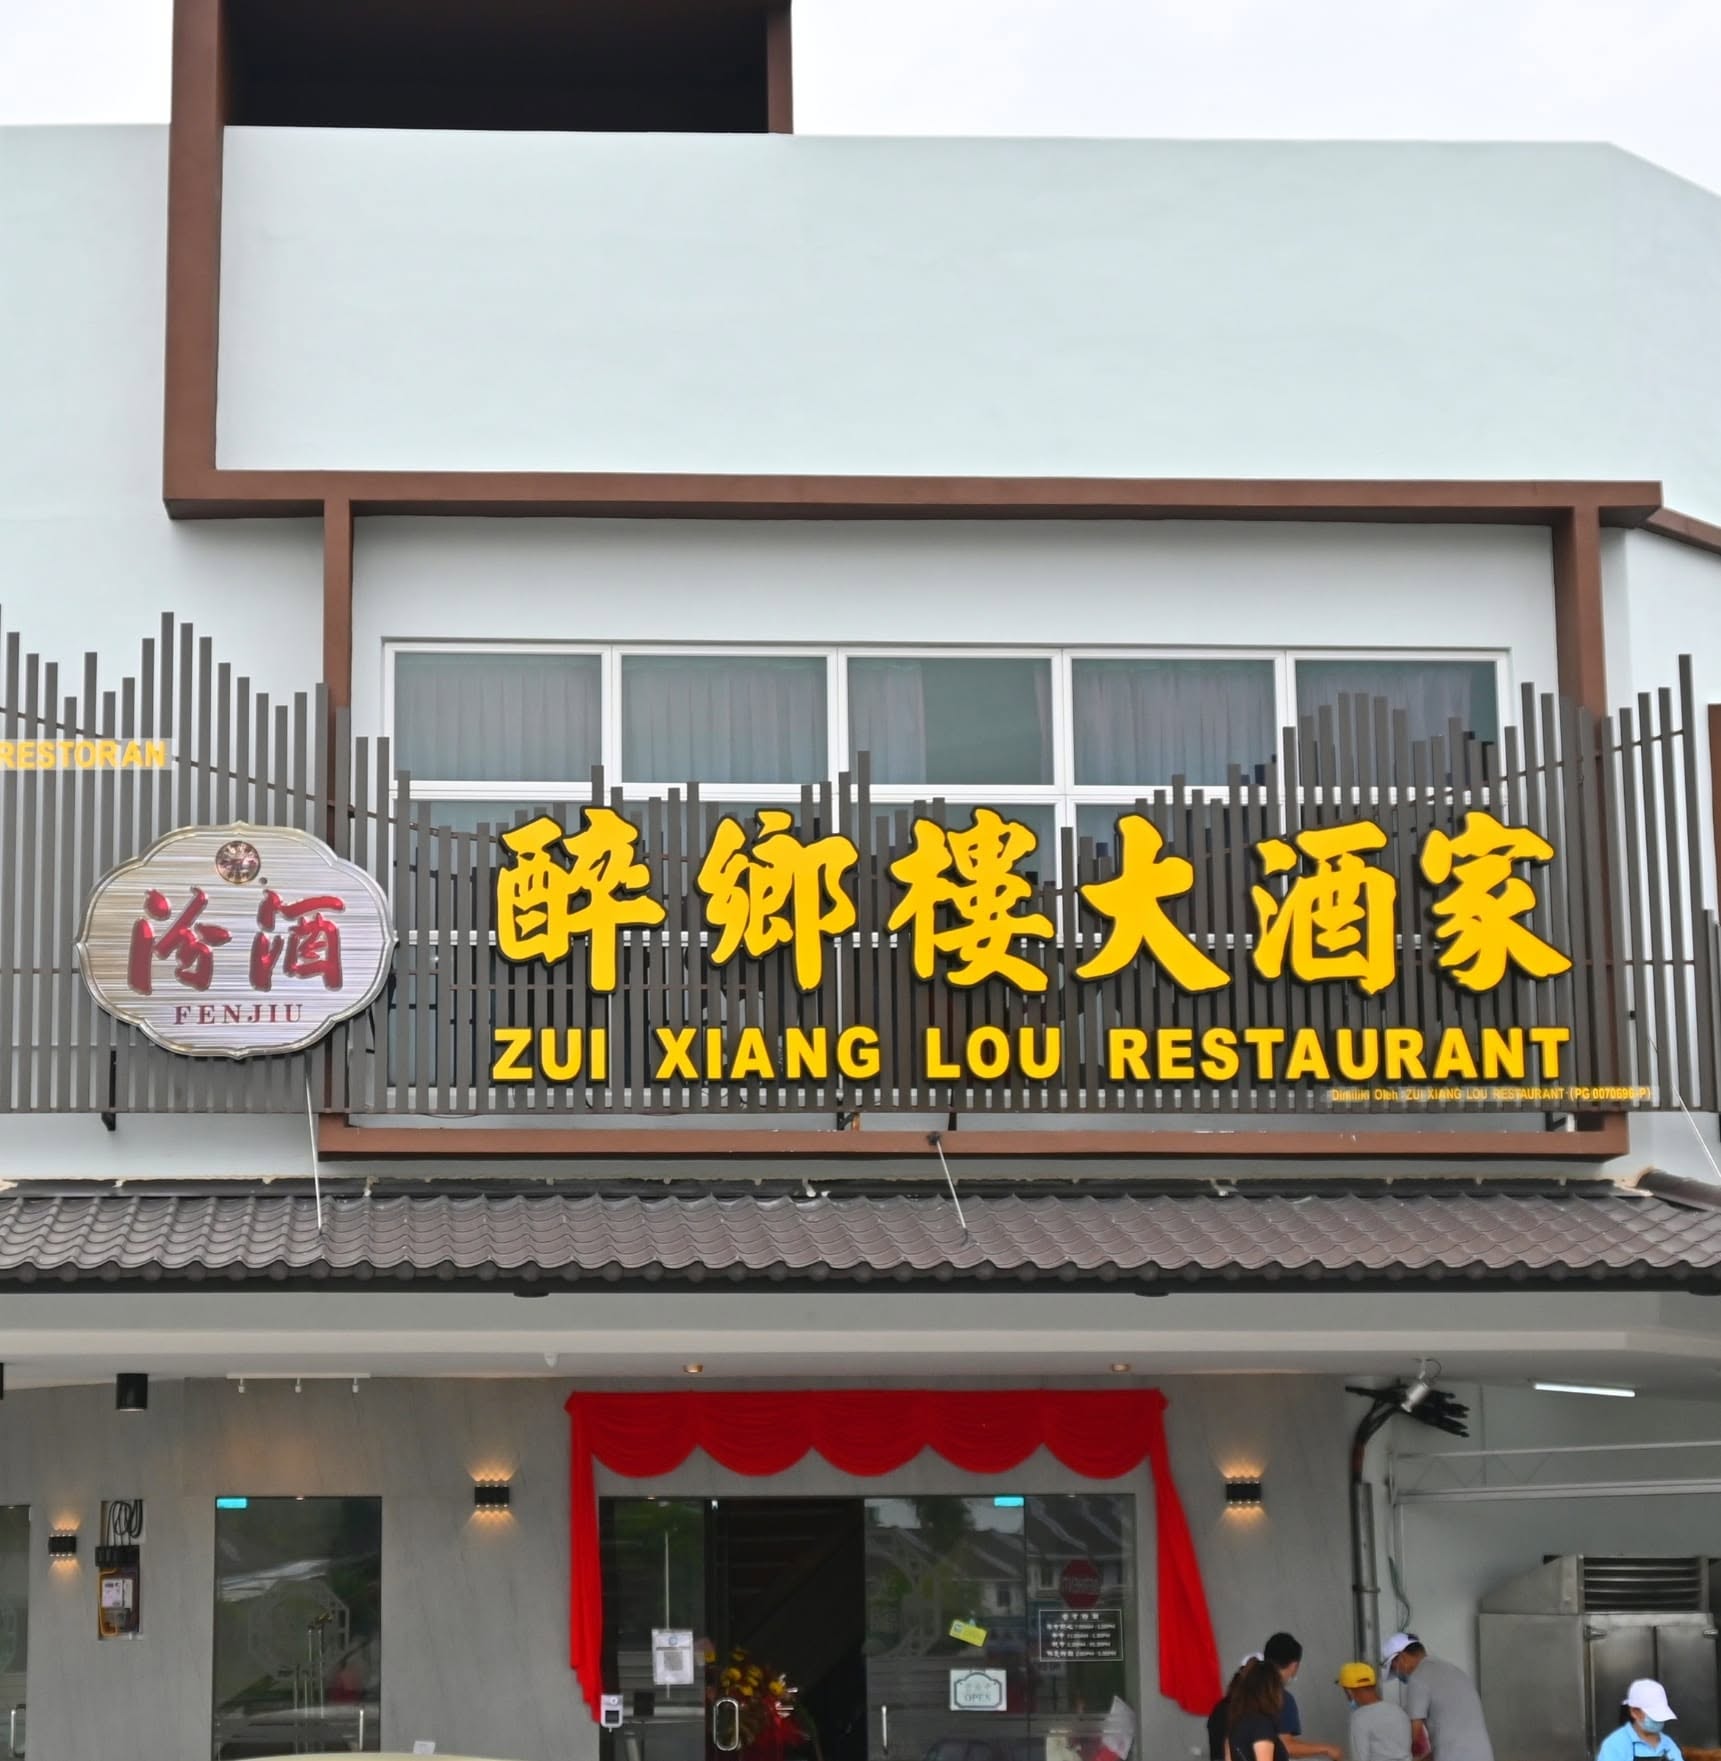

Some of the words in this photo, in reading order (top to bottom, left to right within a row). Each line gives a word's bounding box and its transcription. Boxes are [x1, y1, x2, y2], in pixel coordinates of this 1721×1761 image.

[0, 740, 166, 769] RESTORAN
[497, 808, 1573, 995] 醉鄉樓大酒家
[127, 883, 346, 995] 汾酒
[173, 1003, 304, 1025] FENJIU
[492, 1027, 607, 1081] ZUI
[655, 1025, 881, 1081] XIANG
[925, 1026, 1061, 1080] LOU
[1108, 1027, 1570, 1080] RESTAURANT
[1405, 1088, 1423, 1100] ZUI
[1427, 1087, 1462, 1100] XIANG
[1466, 1087, 1488, 1100] LOU
[1494, 1087, 1565, 1100] RESTAURANT
